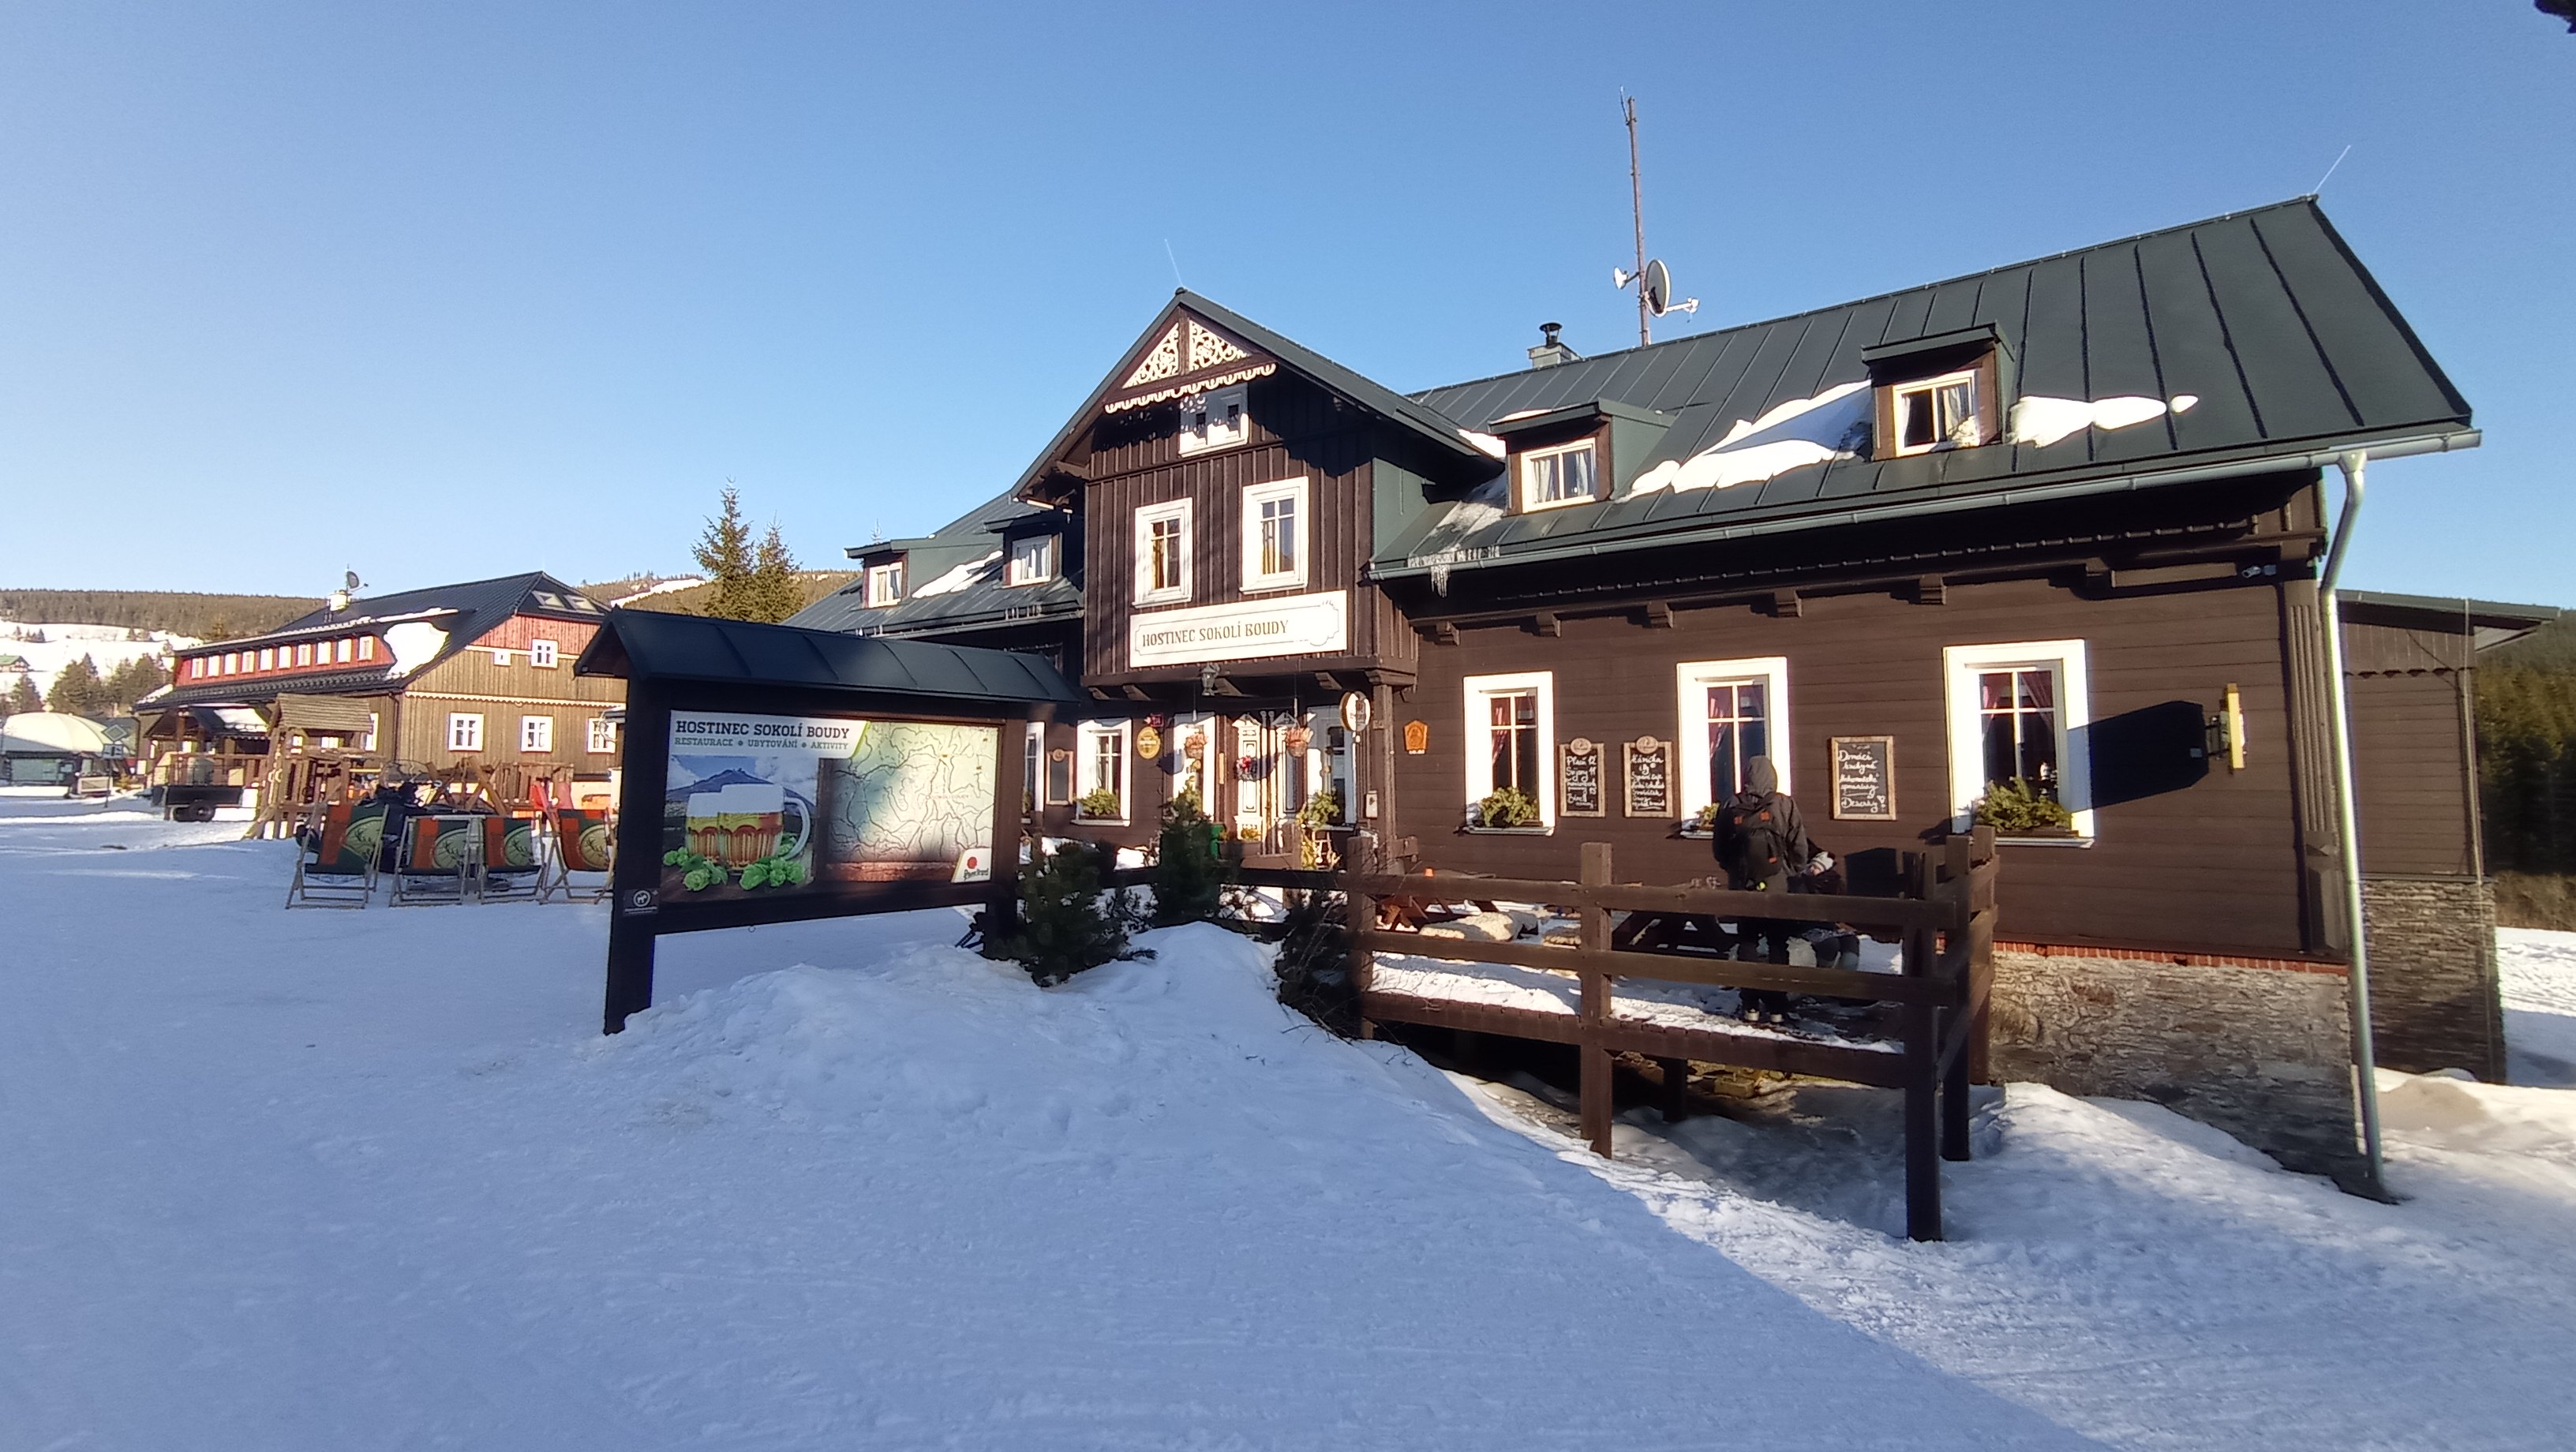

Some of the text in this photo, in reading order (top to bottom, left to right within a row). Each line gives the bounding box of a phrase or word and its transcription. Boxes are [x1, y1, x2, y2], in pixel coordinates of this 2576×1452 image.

[1142, 619, 1289, 647] HOSTINEC SOKOLÍ BOUDY
[676, 720, 850, 739] HOSTINEC SOKOLÍ BOUDY
[674, 737, 848, 750] RESTAURACE UBYTOVÁNÍ AKTIVITY
